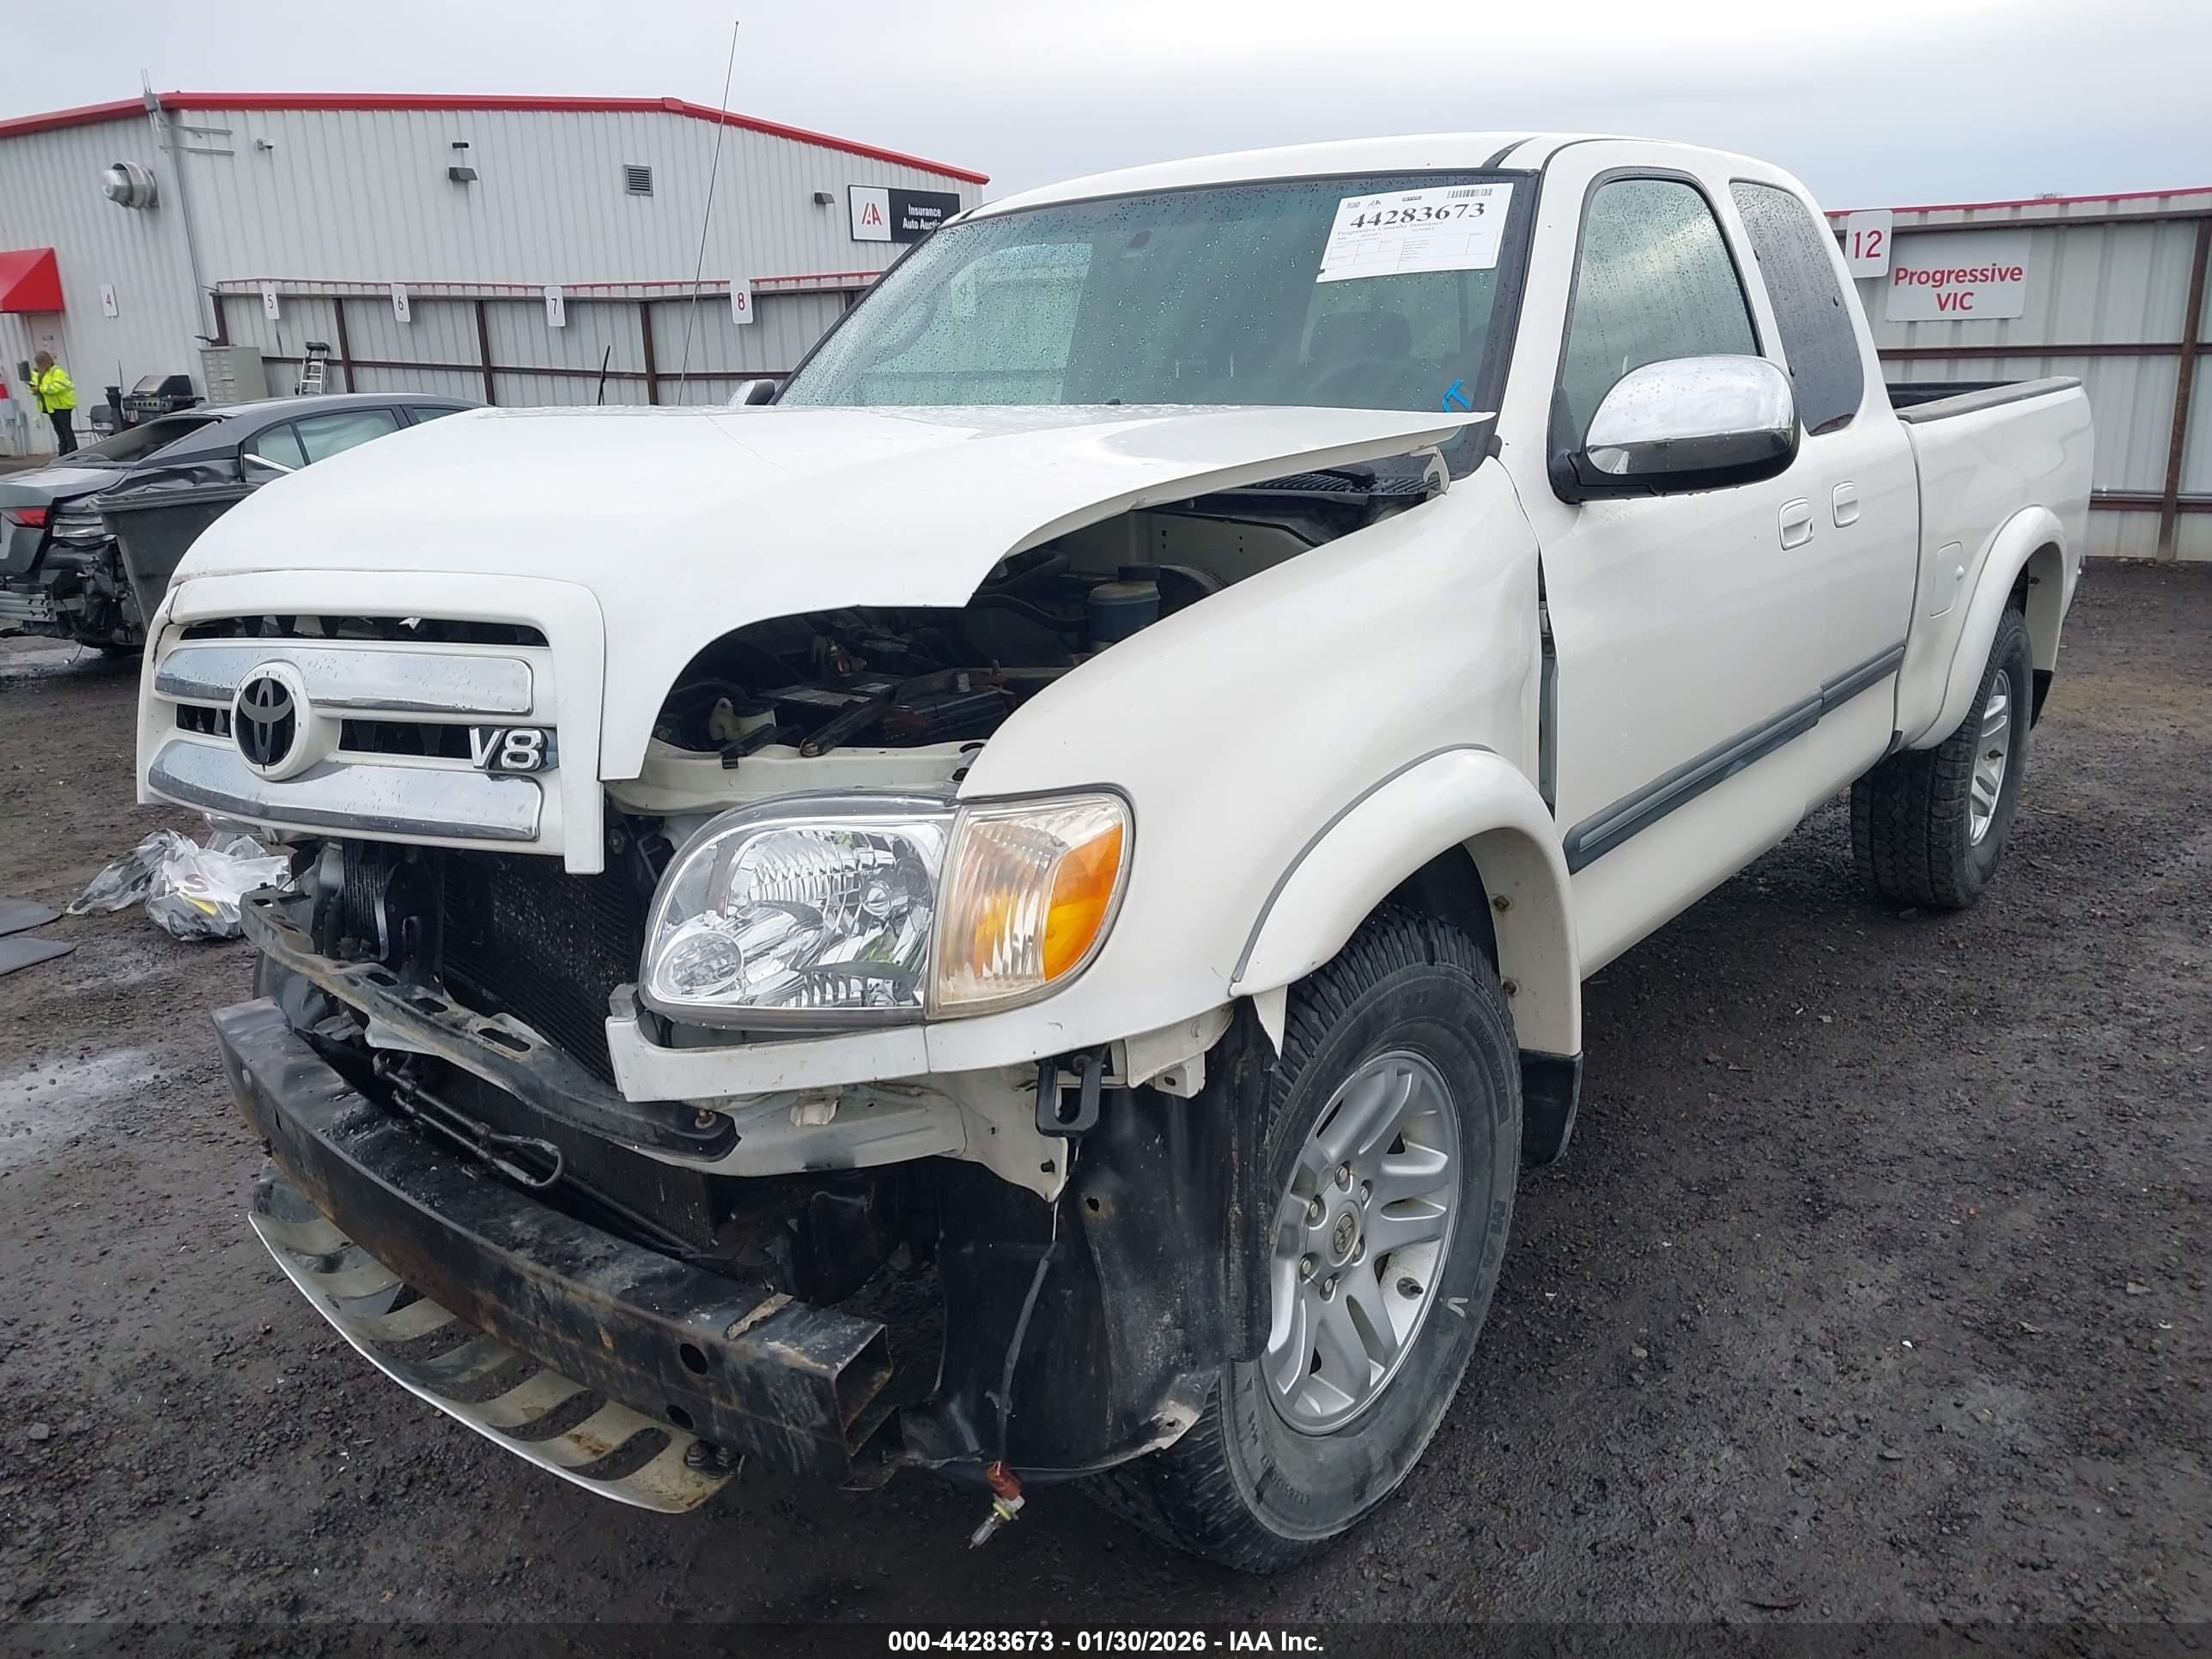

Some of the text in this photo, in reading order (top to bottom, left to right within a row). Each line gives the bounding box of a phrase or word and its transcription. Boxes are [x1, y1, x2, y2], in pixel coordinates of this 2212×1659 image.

[908, 203, 941, 217] Insurance
[1350, 202, 1486, 228] 44283673
[902, 217, 919, 230] Auto
[1854, 229, 1883, 259] 12
[1894, 263, 2023, 289] Progressive
[106, 293, 112, 307] 4
[267, 294, 274, 309] 5
[398, 295, 404, 311] 6
[550, 297, 558, 315] 7
[738, 292, 745, 311] 8
[1936, 292, 1975, 312] VIC
[469, 727, 543, 769] V8
